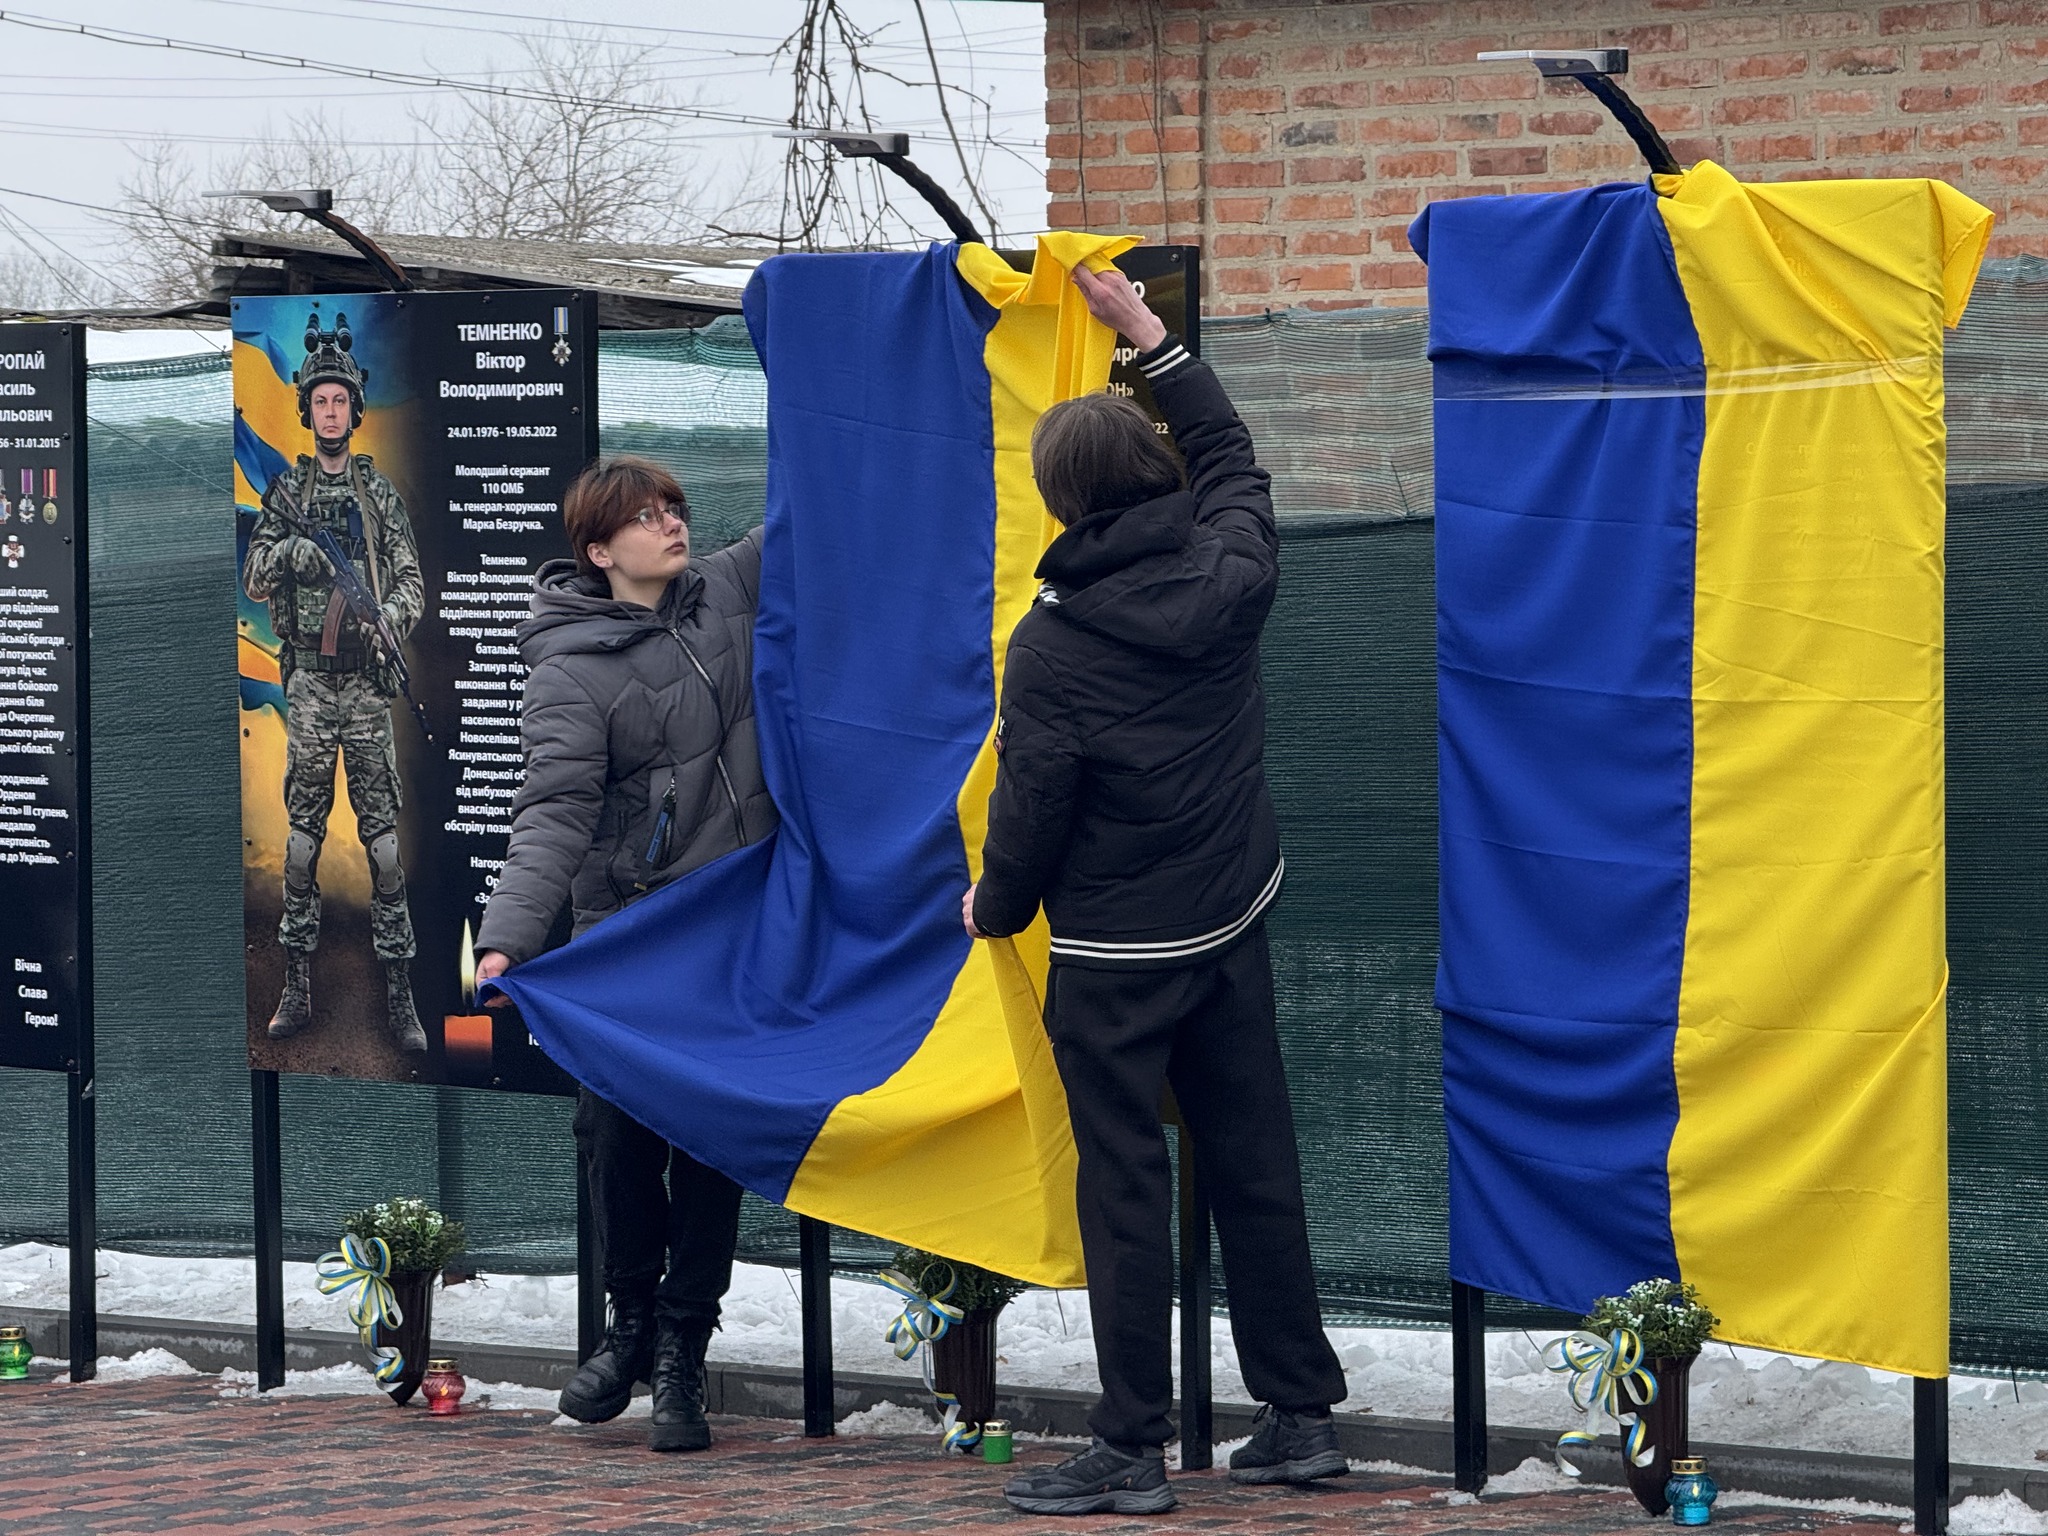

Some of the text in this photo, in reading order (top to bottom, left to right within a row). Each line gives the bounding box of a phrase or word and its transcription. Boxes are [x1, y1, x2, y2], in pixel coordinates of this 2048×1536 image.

[458, 322, 543, 342] ТЕМНЕНКО
[476, 352, 526, 373] Віктор
[440, 381, 564, 401] Володимирович
[447, 426, 500, 438] 24.01.1976
[505, 426, 557, 437] 19.05.2022
[14, 437, 60, 448] 31.01.2015
[455, 464, 550, 479] Молодший сержант
[482, 482, 524, 494] 110 ОМБ
[449, 500, 557, 515] ім. генерал-хорунжого
[463, 518, 544, 533] Марка Безручка.
[480, 553, 528, 566] Темненко
[446, 571, 479, 586] Віктор
[17, 588, 49, 600] солдат,
[440, 592, 490, 604] командир
[12, 601, 60, 615] відділення
[439, 606, 492, 621] відділення
[7, 617, 43, 631] окремої
[28, 632, 65, 647] бригади
[449, 627, 483, 640] взводу
[6, 650, 57, 662] потужності.
[17, 664, 31, 677] під
[31, 667, 48, 676] час
[468, 660, 508, 676] Загинув
[508, 661, 525, 675] під
[18, 679, 59, 692] бойового
[454, 680, 507, 691] виконання
[26, 695, 45, 707] біля
[461, 698, 508, 710] завдання
[508, 700, 515, 711] у
[8, 710, 55, 725] Очеретине
[461, 716, 515, 727] населеного
[32, 727, 65, 742] району
[460, 731, 519, 745] Новоселівка
[21, 742, 56, 755] області.
[448, 748, 524, 763] Ясинуватського
[463, 767, 514, 781] Донецької
[456, 785, 472, 798] від
[32, 807, 69, 819] ступеня,
[458, 803, 506, 817] внаслідок
[444, 820, 486, 835] обстрілу
[7, 853, 19, 863] до
[15, 957, 42, 973] Вічна
[18, 984, 48, 1000] Слава
[25, 1011, 59, 1027] Герою!
